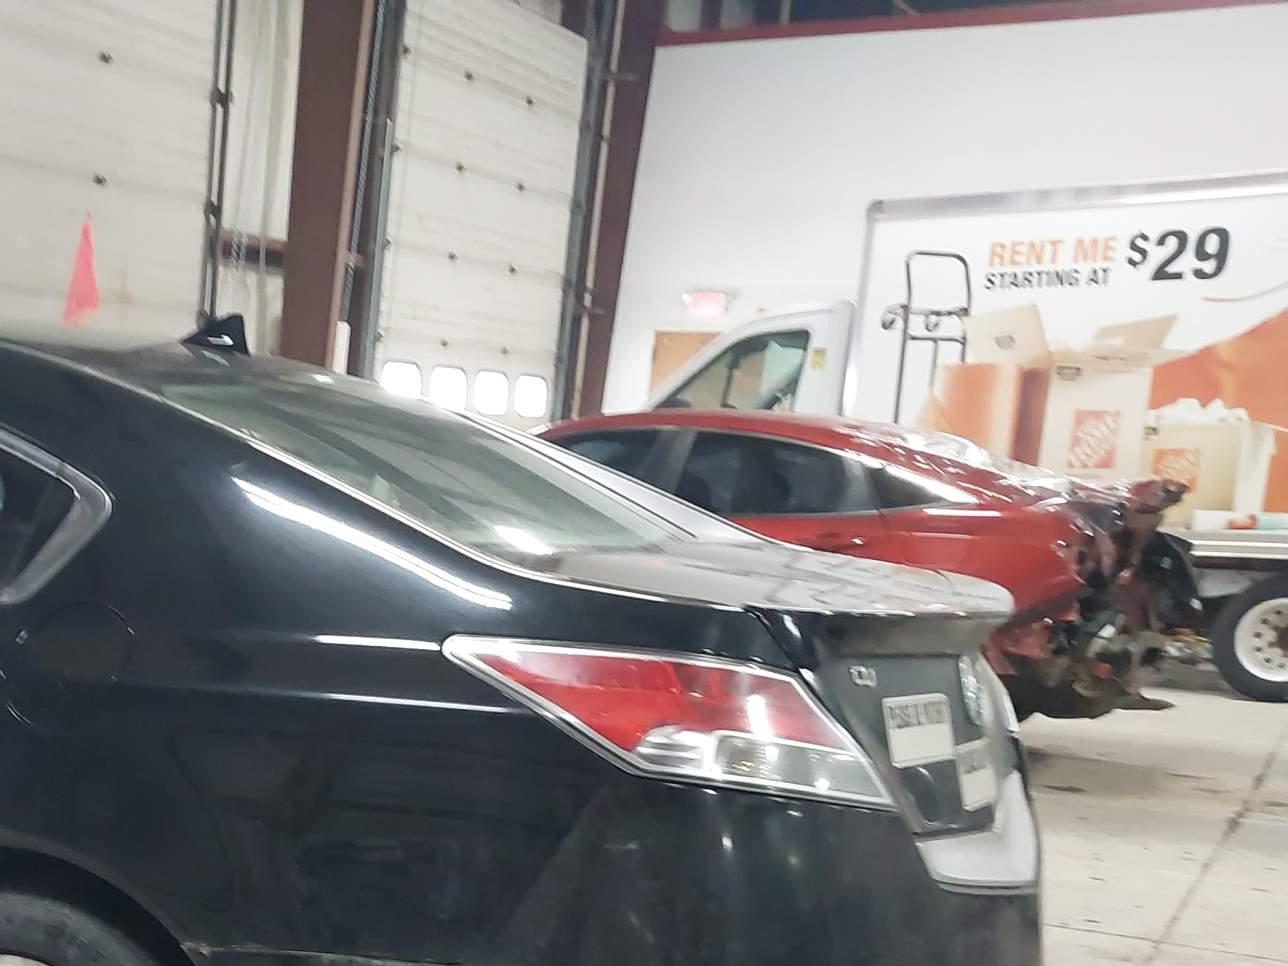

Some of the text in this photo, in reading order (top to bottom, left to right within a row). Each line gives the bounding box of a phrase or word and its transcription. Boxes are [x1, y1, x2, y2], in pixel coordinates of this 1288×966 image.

[989, 227, 1231, 281] RENT ME $29
[984, 267, 1112, 290] STARTING AT
